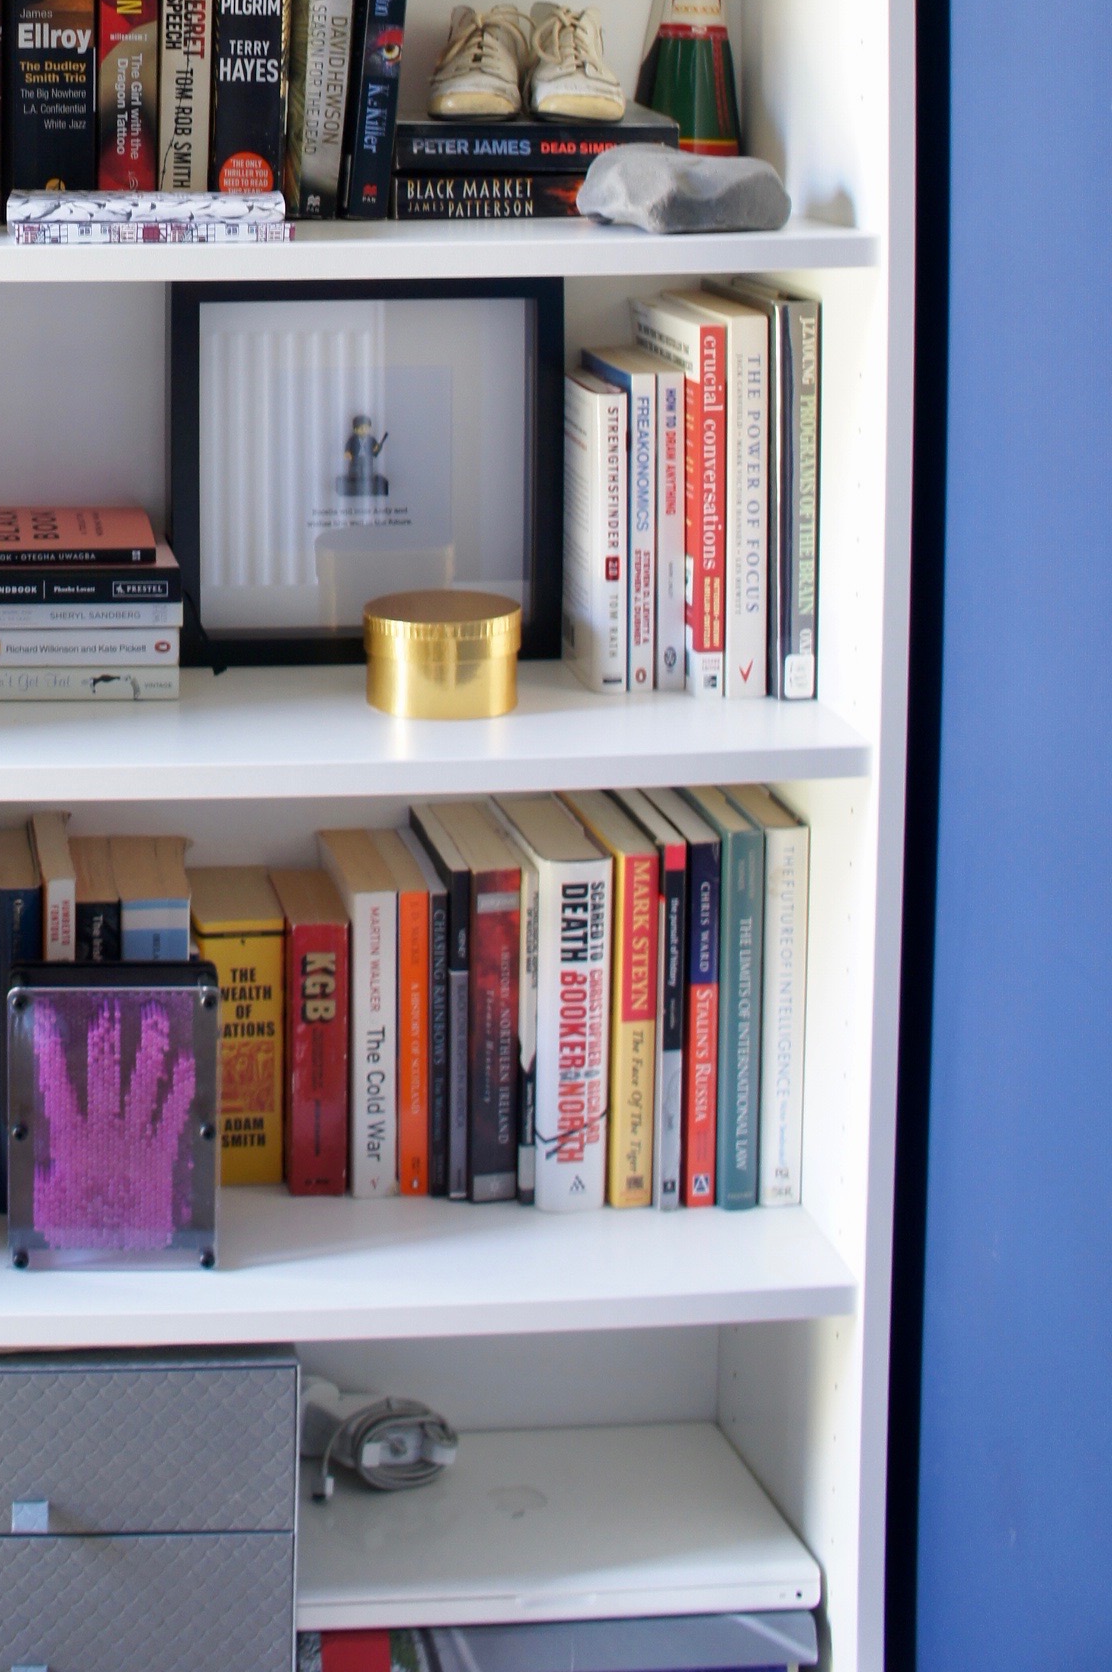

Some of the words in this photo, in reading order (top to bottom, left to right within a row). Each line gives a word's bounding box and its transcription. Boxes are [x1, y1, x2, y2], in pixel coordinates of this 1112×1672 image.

[20, 8, 54, 19] James
[17, 22, 92, 55] Ellroy
[229, 39, 270, 57] TERRY
[20, 61, 44, 71] The
[46, 60, 87, 74] Dudley
[25, 72, 60, 84] Smith
[64, 72, 87, 84] Trio
[130, 52, 144, 77] The
[219, 58, 279, 83] HAYES
[21, 87, 35, 99] The
[37, 87, 49, 101] Big
[51, 87, 87, 99] Nowhere
[114, 57, 128, 106] Dragon
[130, 78, 144, 106] Girl
[174, 67, 194, 100] TOM
[23, 103, 38, 115] L.A.
[40, 103, 87, 115] Confidential
[43, 118, 65, 130] White
[67, 118, 87, 131] Jazz
[130, 107, 143, 138] with
[174, 103, 193, 131] ROB
[114, 110, 128, 156] Tattoo
[411, 138, 469, 155] PETER
[471, 138, 532, 156] JAMES
[129, 139, 143, 161] the
[172, 134, 193, 189] SMITH
[406, 179, 455, 199] BLACK
[462, 177, 533, 198] MARKET
[408, 201, 444, 212] JAMES
[448, 199, 534, 218] PATTERSON
[703, 334, 725, 413] crucial
[748, 355, 761, 400] THE
[634, 395, 650, 534] FREAKONOMICS
[747, 410, 761, 490] POWER
[606, 406, 619, 549] STRENGTHSFINDER
[702, 419, 724, 571] conversations
[746, 500, 760, 529] OF
[745, 539, 760, 614] FOCUS
[631, 859, 651, 934] MARK
[560, 882, 589, 964] DEATH
[230, 967, 256, 983] THE
[301, 951, 337, 1024] KGB
[630, 936, 650, 1011] STEYN
[221, 986, 272, 1002] WEALTH
[234, 1003, 251, 1019] OF
[558, 970, 588, 1069] BOOKER
[366, 1026, 386, 1064] The
[366, 1069, 386, 1116] Cold
[224, 1118, 264, 1131] ADAM
[555, 1081, 587, 1164] NORTH
[221, 1131, 266, 1148] SMITH
[366, 1119, 386, 1163] War
